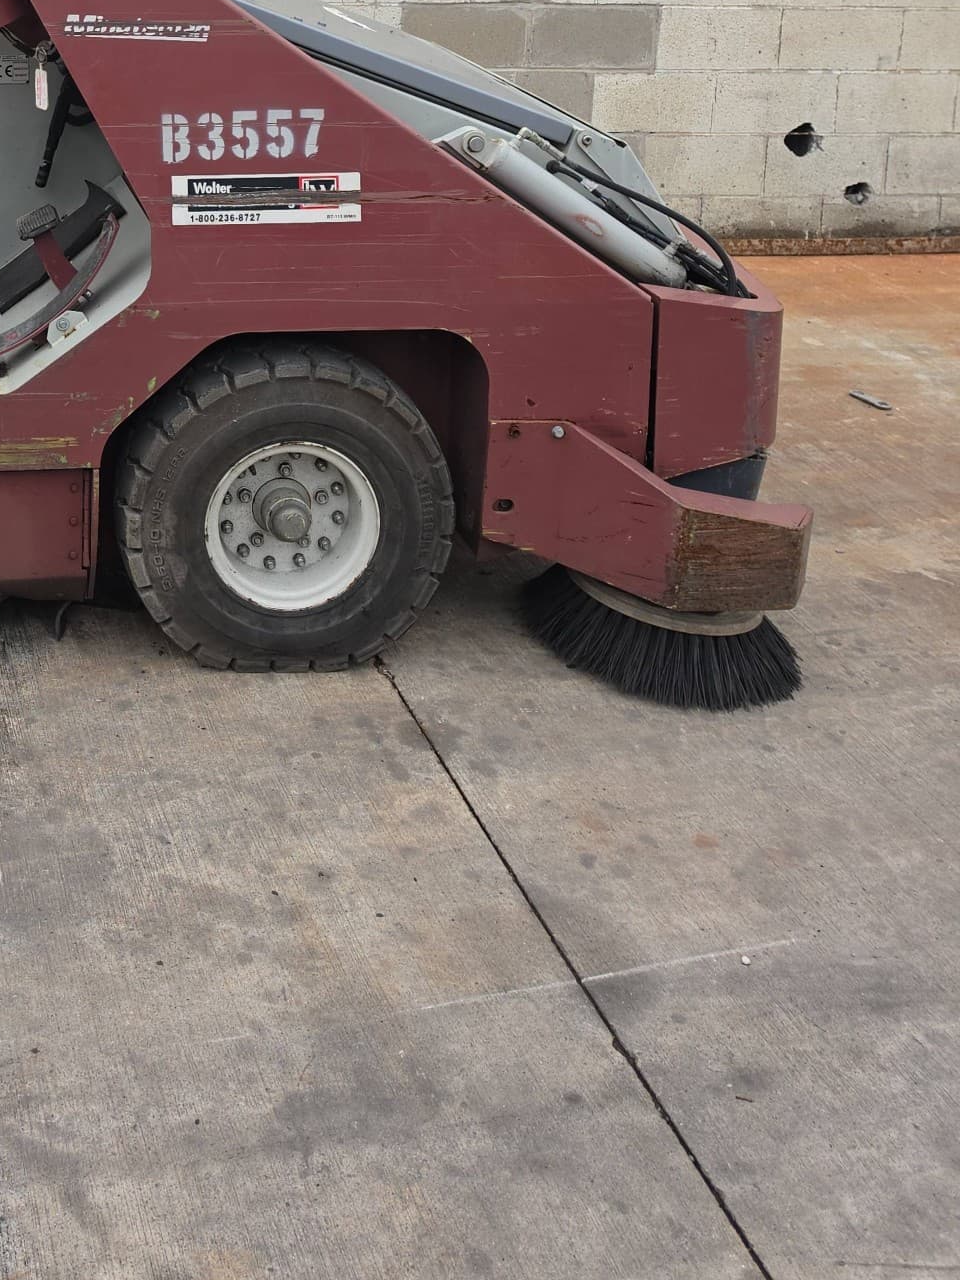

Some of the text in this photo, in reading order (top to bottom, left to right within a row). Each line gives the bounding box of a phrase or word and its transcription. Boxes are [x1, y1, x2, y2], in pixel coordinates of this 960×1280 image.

[160, 108, 325, 164] B3557
[193, 181, 233, 195] Wolter
[190, 213, 261, 223] 1-800-236-8727
